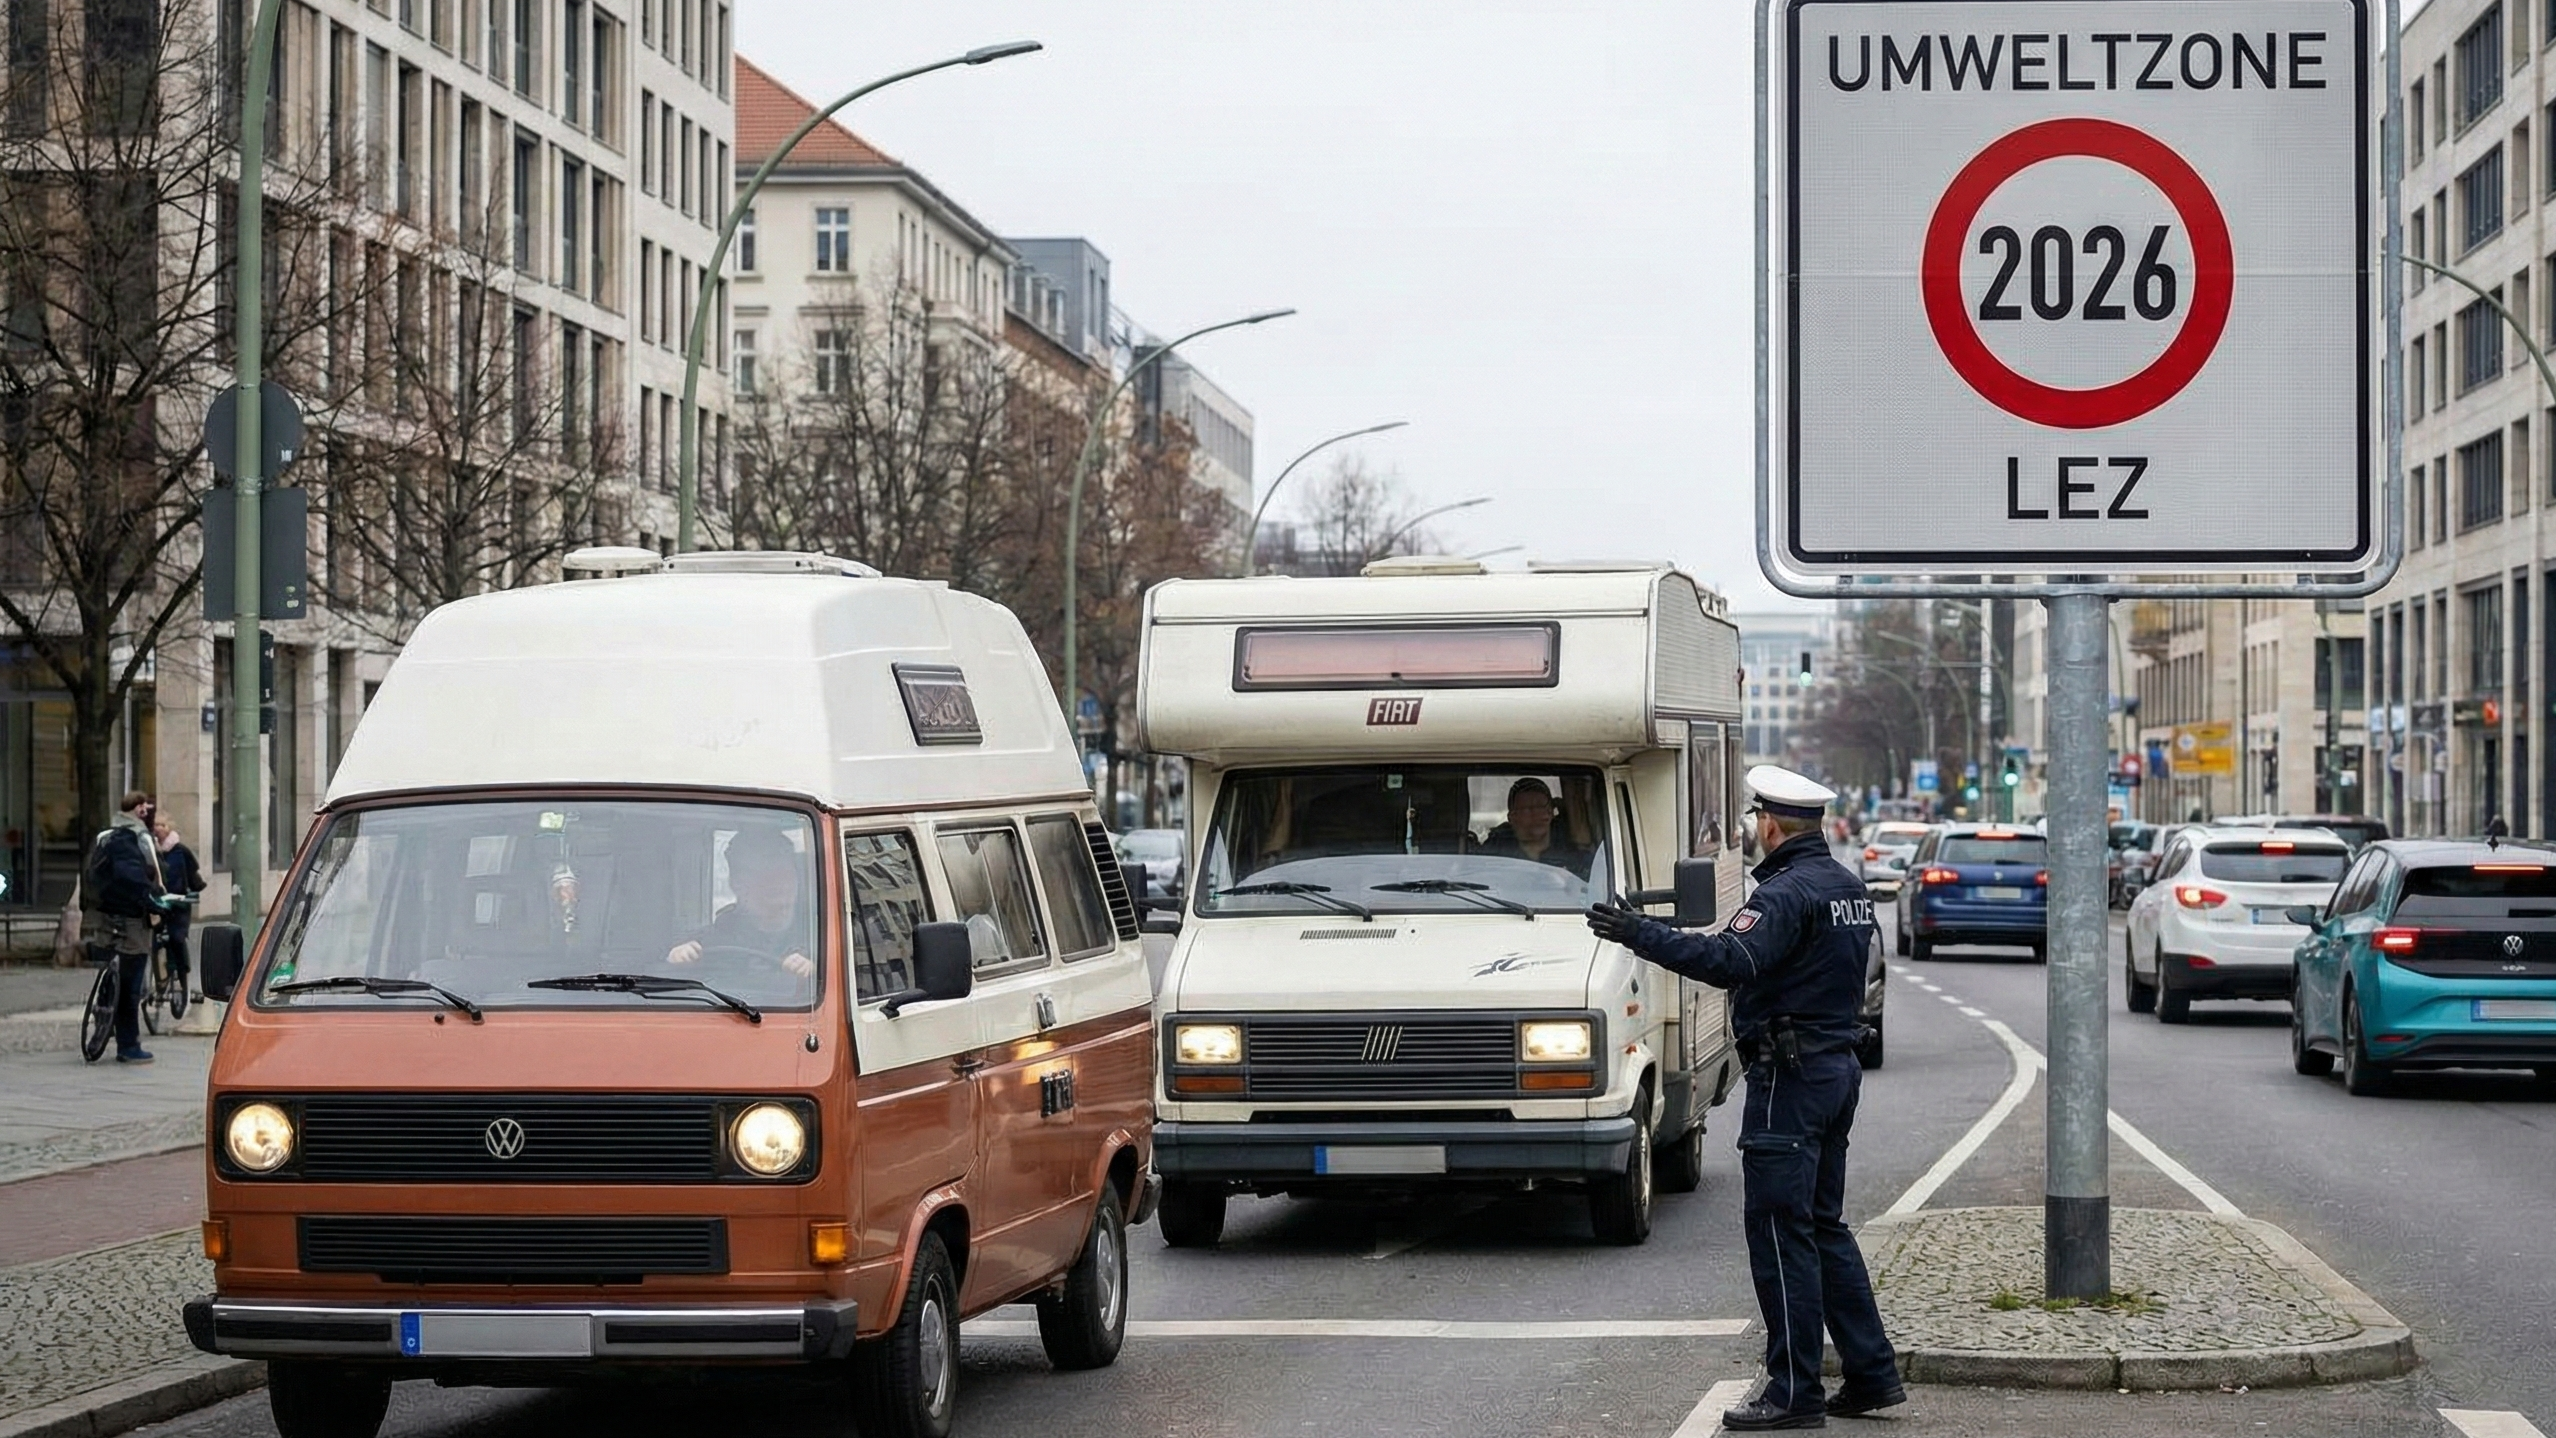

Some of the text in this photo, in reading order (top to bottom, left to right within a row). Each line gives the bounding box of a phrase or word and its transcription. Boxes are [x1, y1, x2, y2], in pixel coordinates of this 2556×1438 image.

[1828, 32, 2327, 92] UMWELTZONE
[1979, 225, 2177, 321] 2026
[2007, 456, 2149, 520] LEZ
[1372, 700, 1419, 723] FIAT
[485, 1118, 525, 1159] VW
